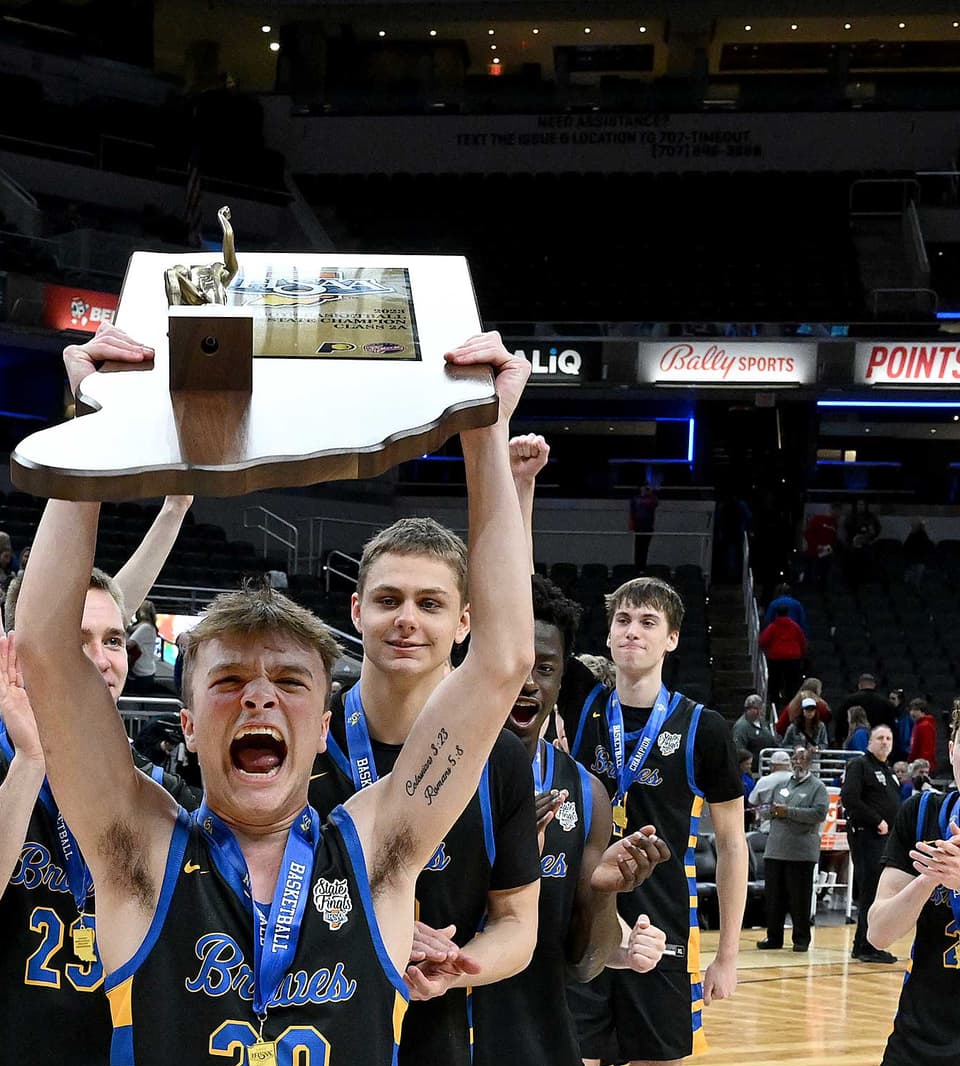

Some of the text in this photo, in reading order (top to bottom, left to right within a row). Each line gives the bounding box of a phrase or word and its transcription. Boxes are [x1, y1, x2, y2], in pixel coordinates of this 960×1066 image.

[660, 343, 794, 379] Bally SPORTS
[315, 878, 348, 895] State
[271, 861, 307, 954] BASKETBALL
[314, 893, 352, 912] Finals
